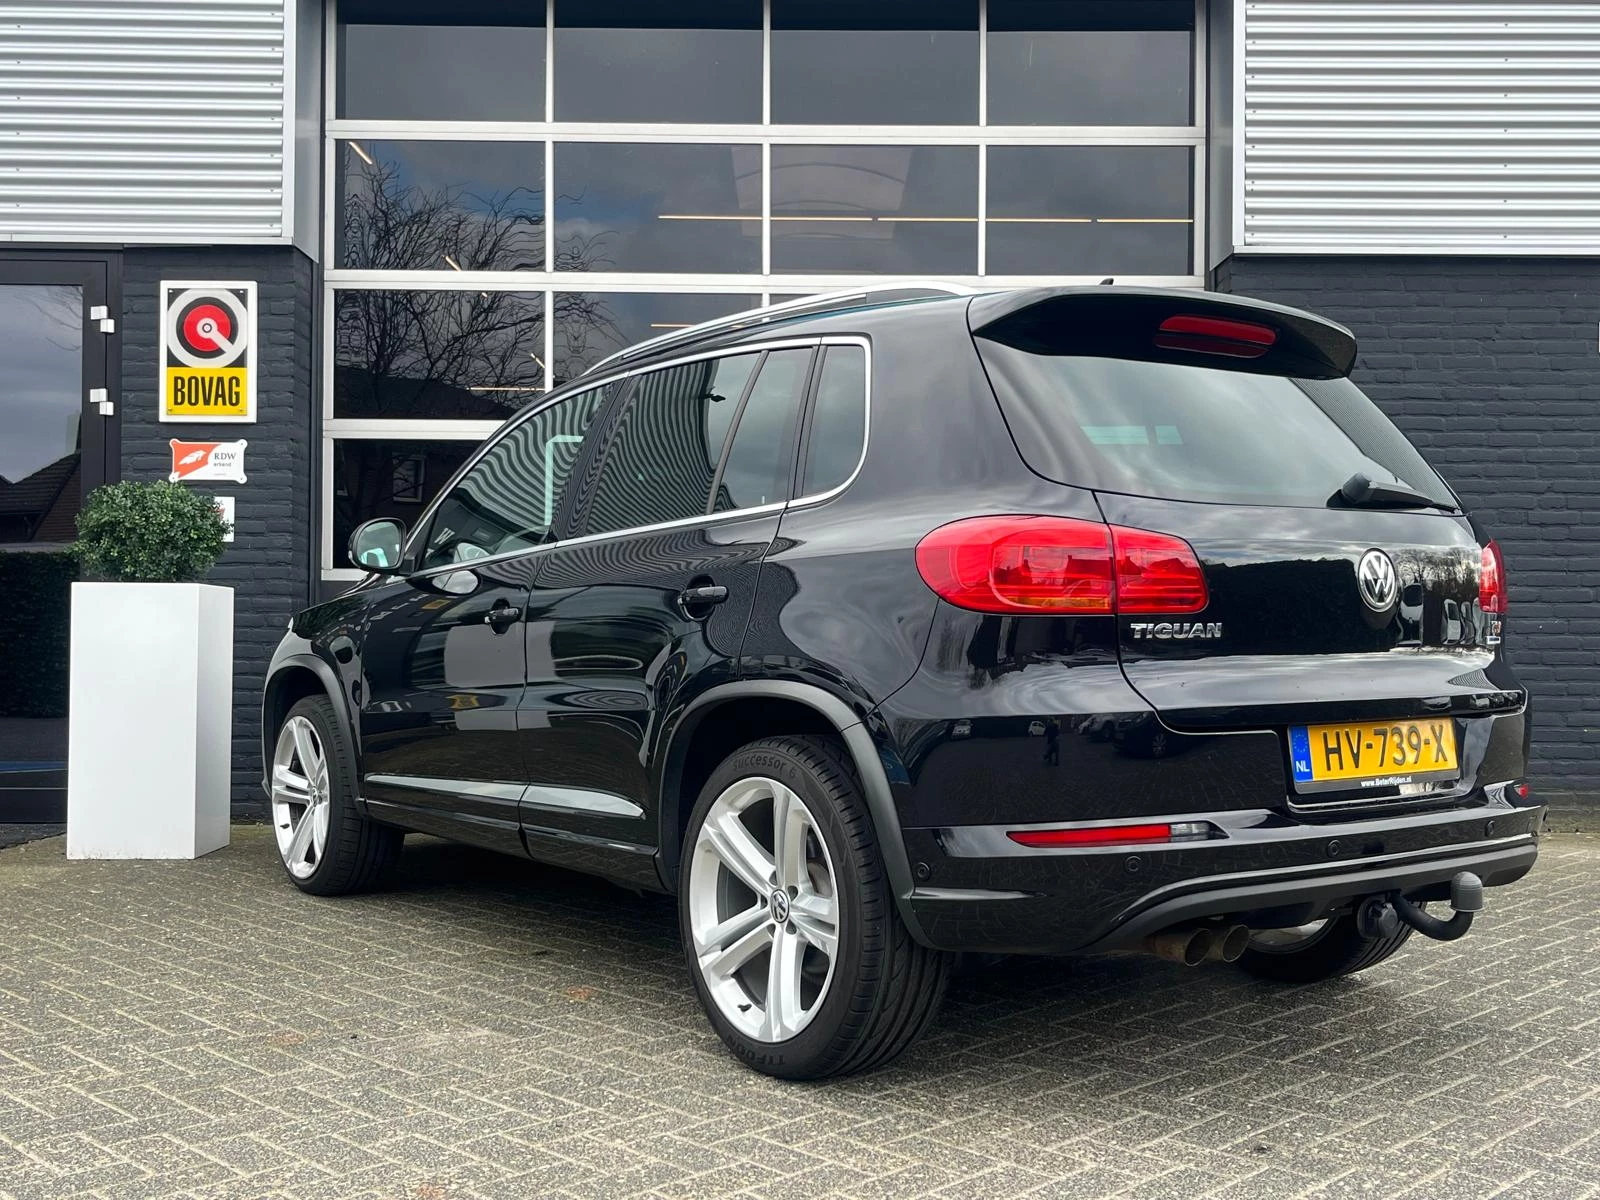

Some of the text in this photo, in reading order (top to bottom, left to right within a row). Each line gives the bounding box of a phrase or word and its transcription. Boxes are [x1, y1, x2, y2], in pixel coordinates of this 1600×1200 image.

[173, 376, 241, 407] BOVAG
[214, 452, 237, 460] RDW
[1130, 622, 1222, 639] TIGUAN
[1322, 723, 1448, 772] HV-739-X
[1295, 760, 1310, 773] NL
